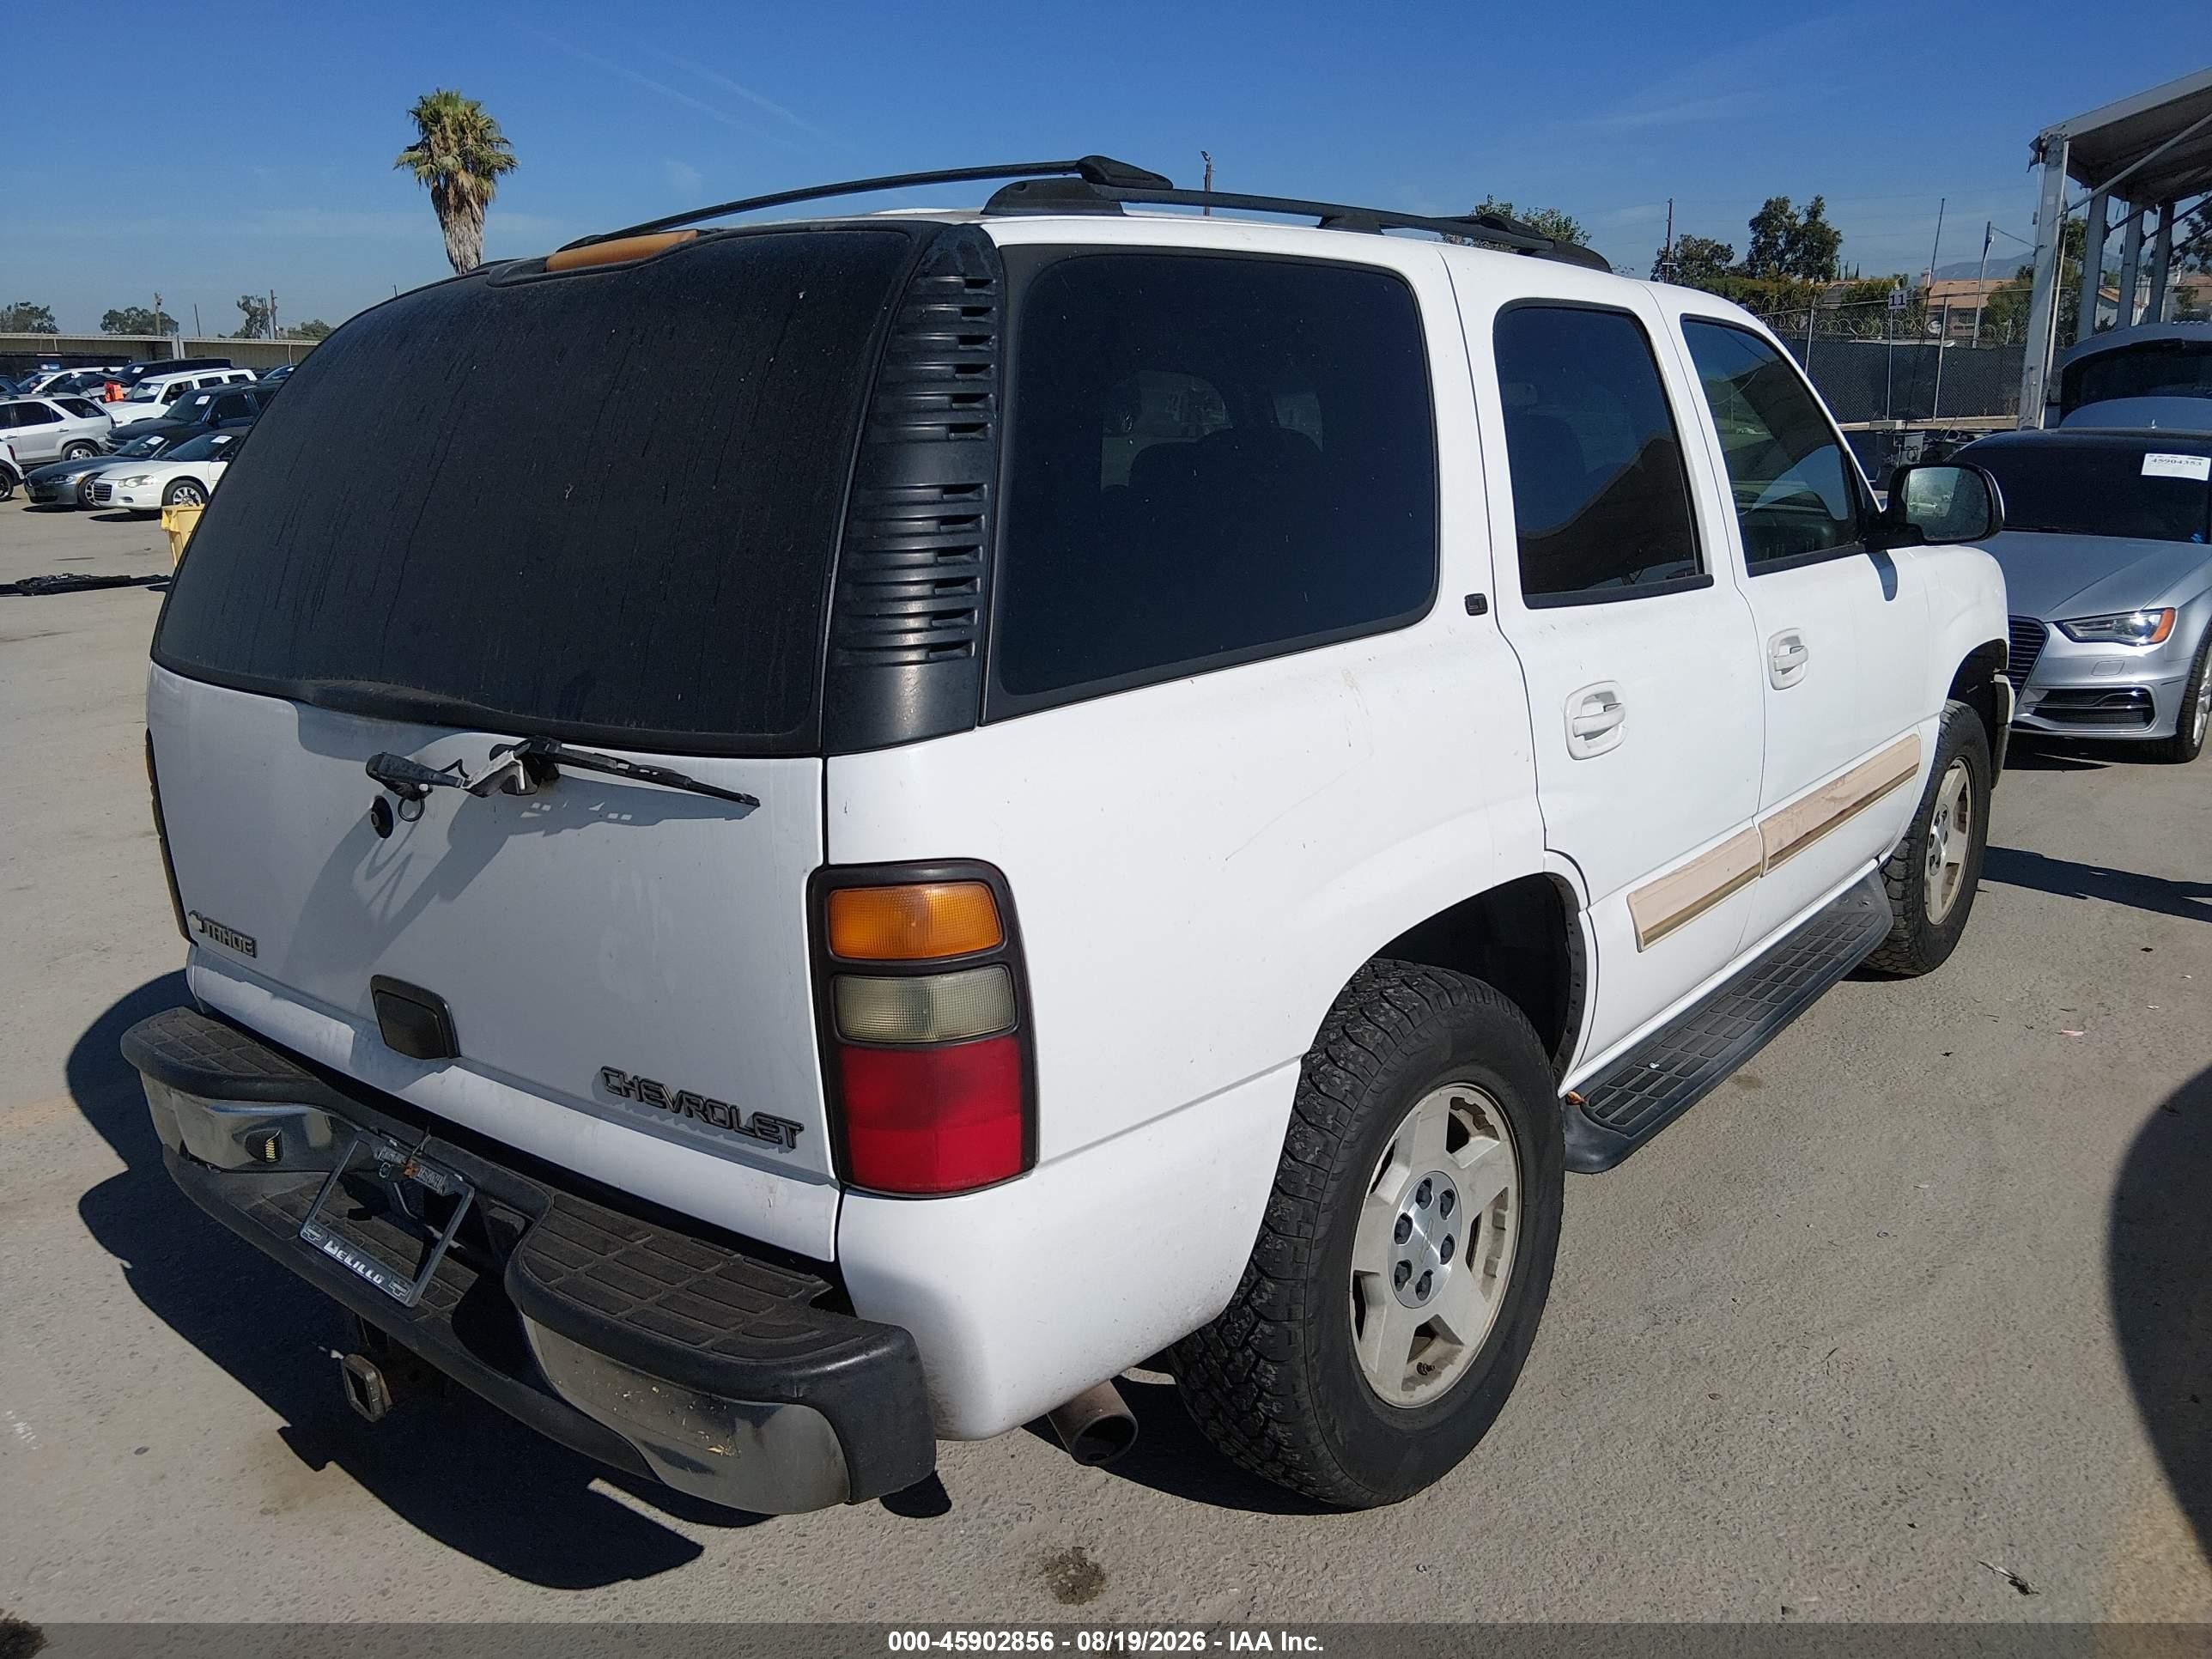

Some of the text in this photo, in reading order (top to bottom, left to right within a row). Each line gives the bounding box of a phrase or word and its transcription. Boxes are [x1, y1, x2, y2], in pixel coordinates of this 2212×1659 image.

[1889, 294, 1905, 307] 11
[204, 917, 257, 958] TAHOE
[601, 1066, 805, 1149] CHEVROLET
